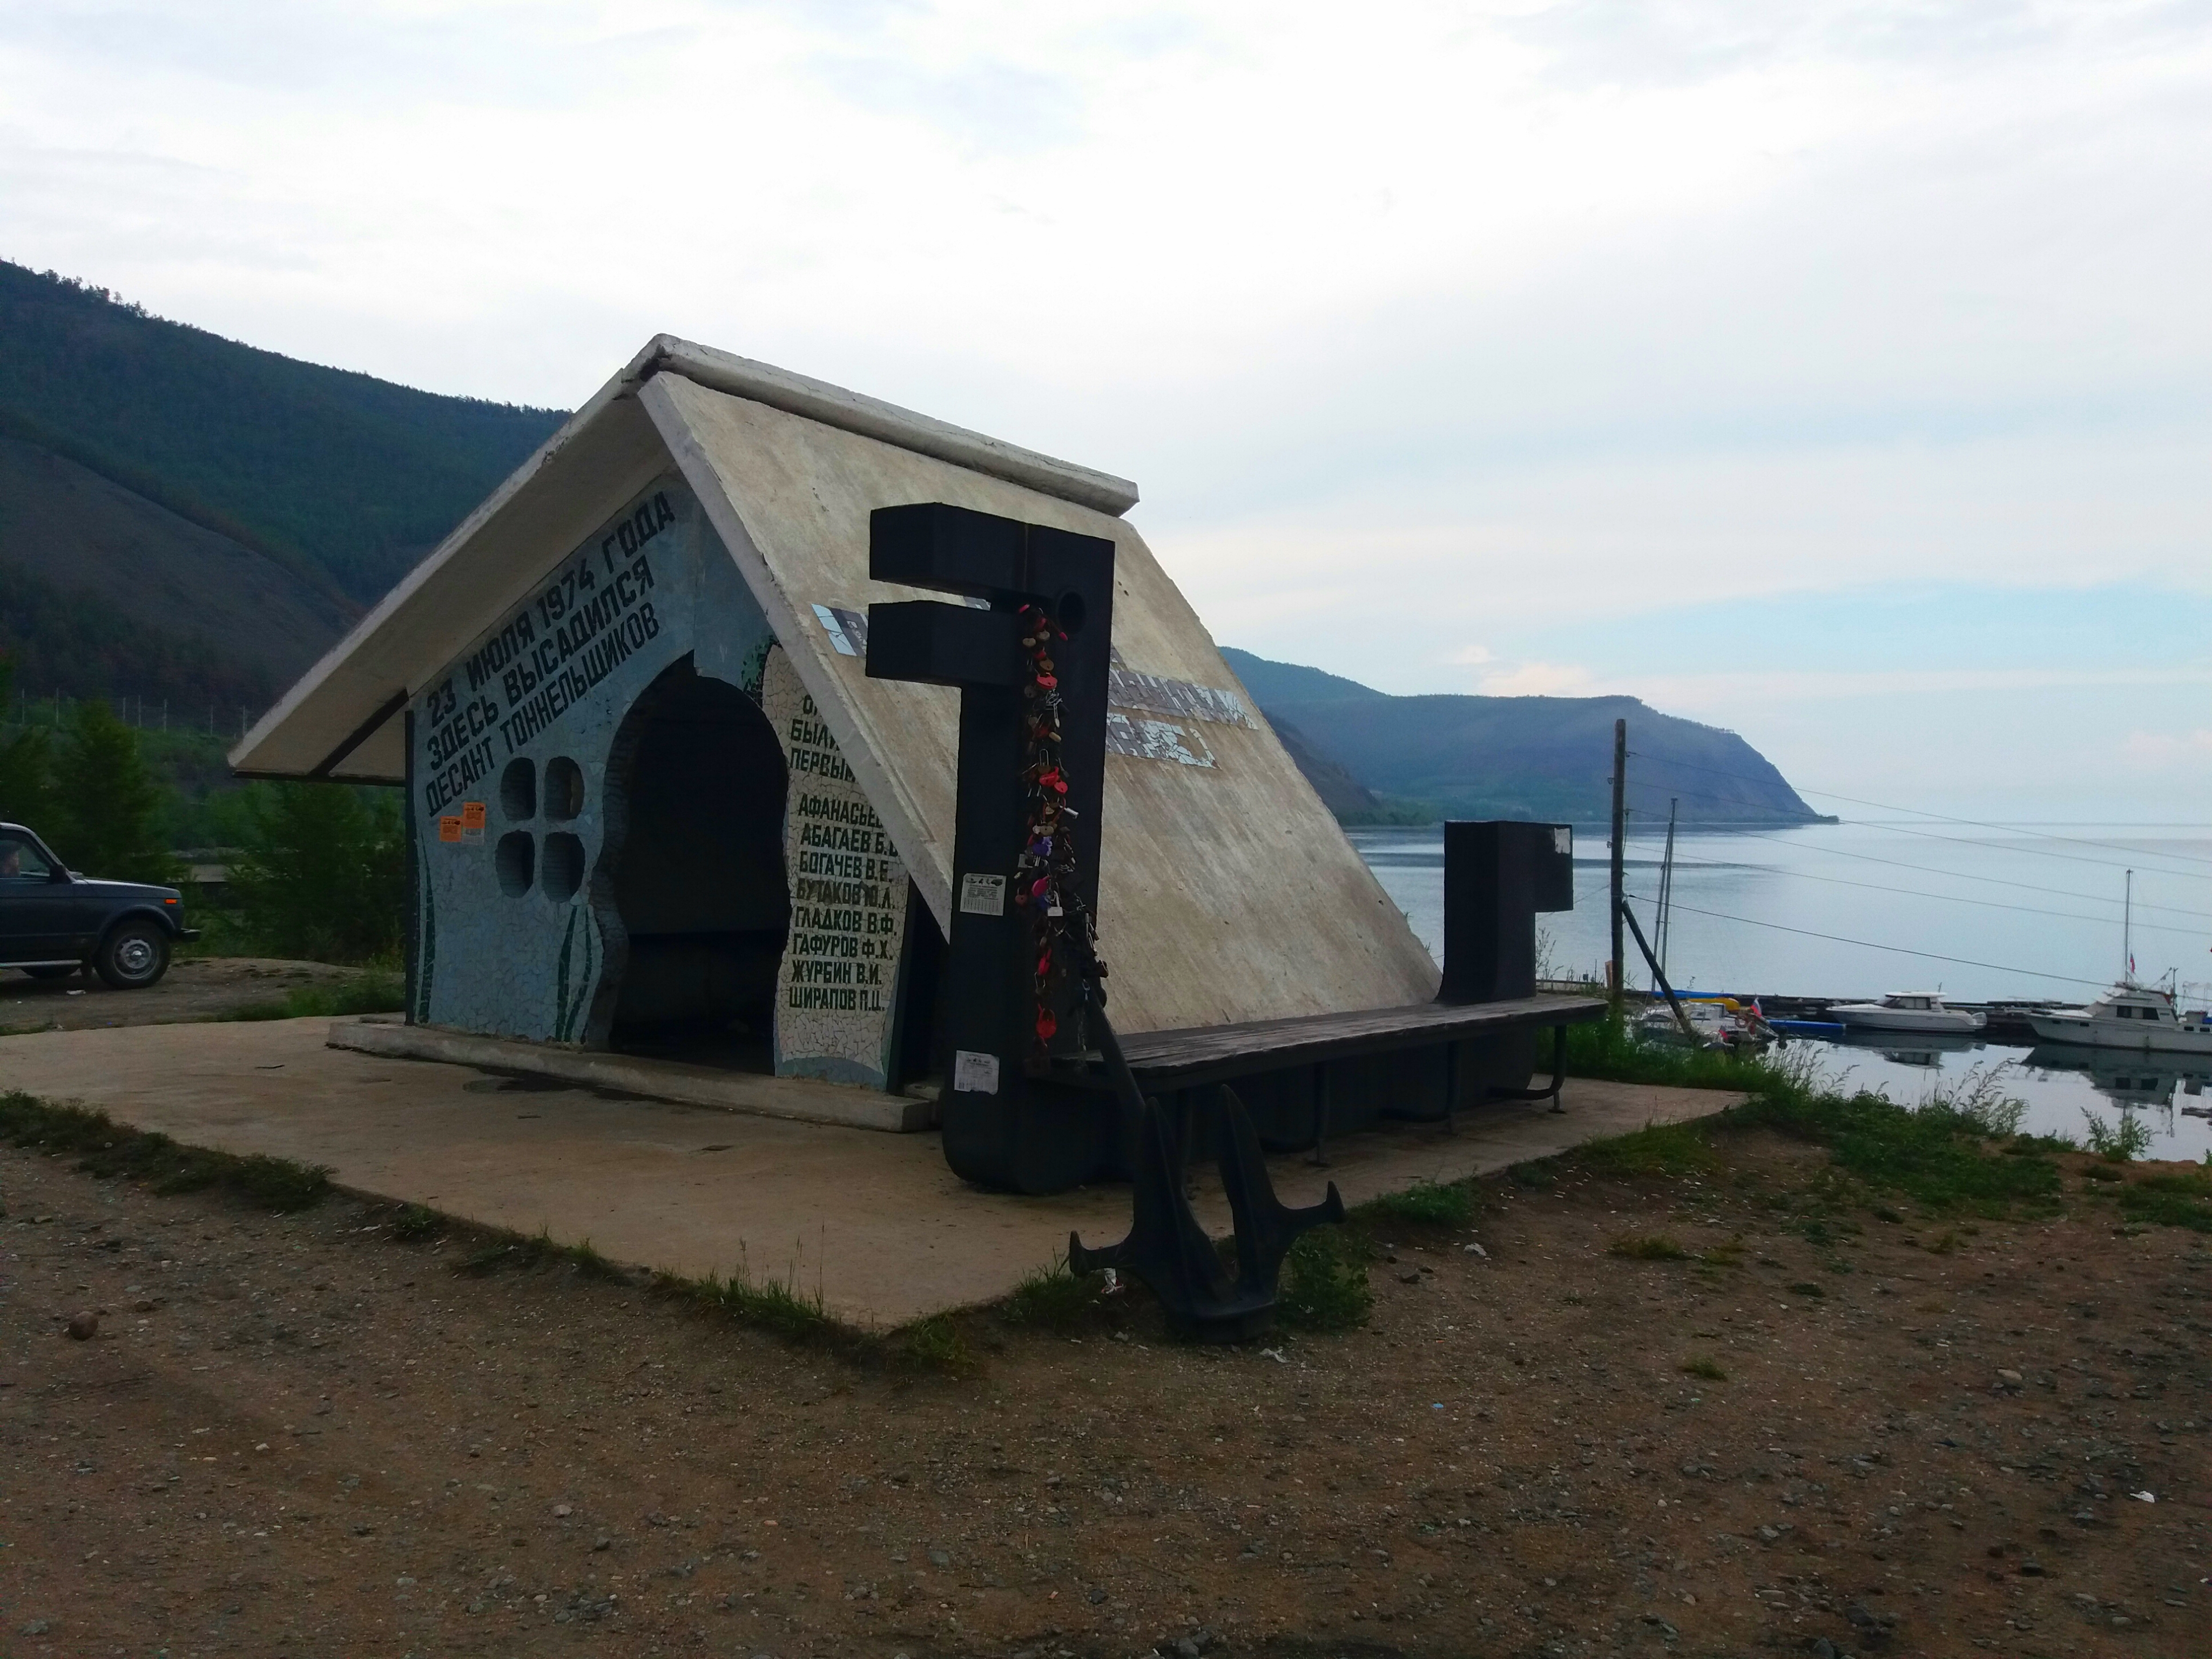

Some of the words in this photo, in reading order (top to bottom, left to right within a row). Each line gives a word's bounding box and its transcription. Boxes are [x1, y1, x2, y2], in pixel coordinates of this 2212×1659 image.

[427, 678, 456, 729] 23
[466, 611, 535, 692] ИЮЛЯ
[537, 559, 596, 628] 1974
[602, 491, 676, 574] ГОДА
[428, 695, 499, 771] ЗДЕСЬ
[503, 554, 655, 708] ВЫСАДИЛСЯ
[426, 736, 495, 818] ДЕСАНТ
[499, 603, 660, 755] ТОННЕЛЬЩИКОВ
[800, 823, 871, 852] АБАГАЕВ
[800, 851, 861, 878] БОГАЧЕВ
[795, 906, 862, 932] ГЛАДКОВ
[867, 913, 897, 936] В.Ф.
[793, 933, 858, 957] ГАФУРОВ
[862, 939, 893, 960] Ф.Х.
[791, 960, 851, 983] ЖУРБИН
[857, 963, 882, 984] В.И.
[790, 987, 856, 1010] ШИРАПОВ
